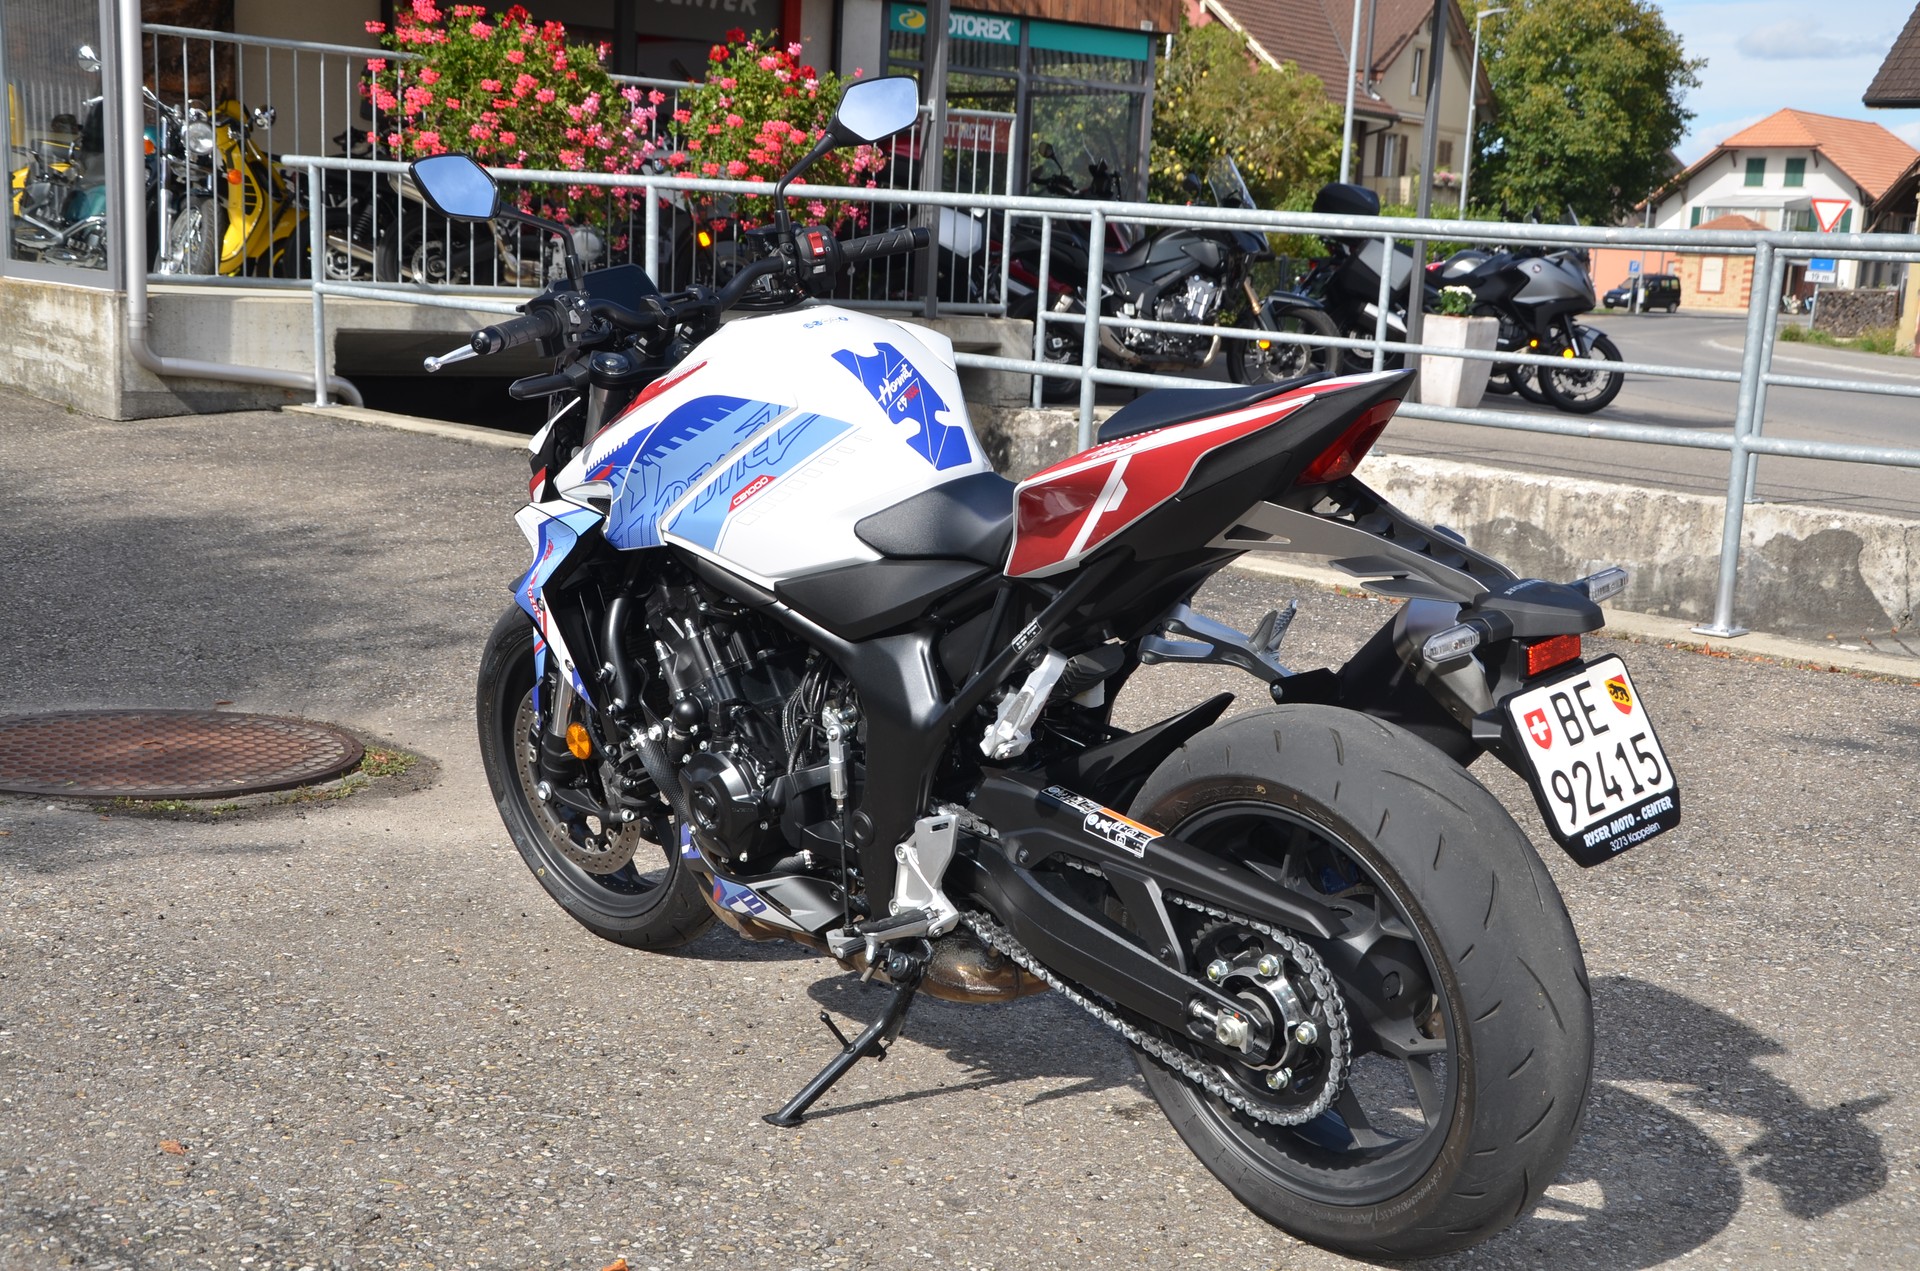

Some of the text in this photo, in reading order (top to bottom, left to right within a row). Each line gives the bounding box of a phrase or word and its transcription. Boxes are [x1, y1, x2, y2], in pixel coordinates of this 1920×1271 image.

[732, 475, 770, 507] CB1000
[1549, 680, 1610, 747] BE
[1551, 731, 1662, 826] 92415
[1582, 824, 1612, 848] RYSER
[1609, 813, 1636, 836] MOTO
[1641, 795, 1674, 820] CENTER
[1609, 821, 1662, 852] 3273 Kappelen
